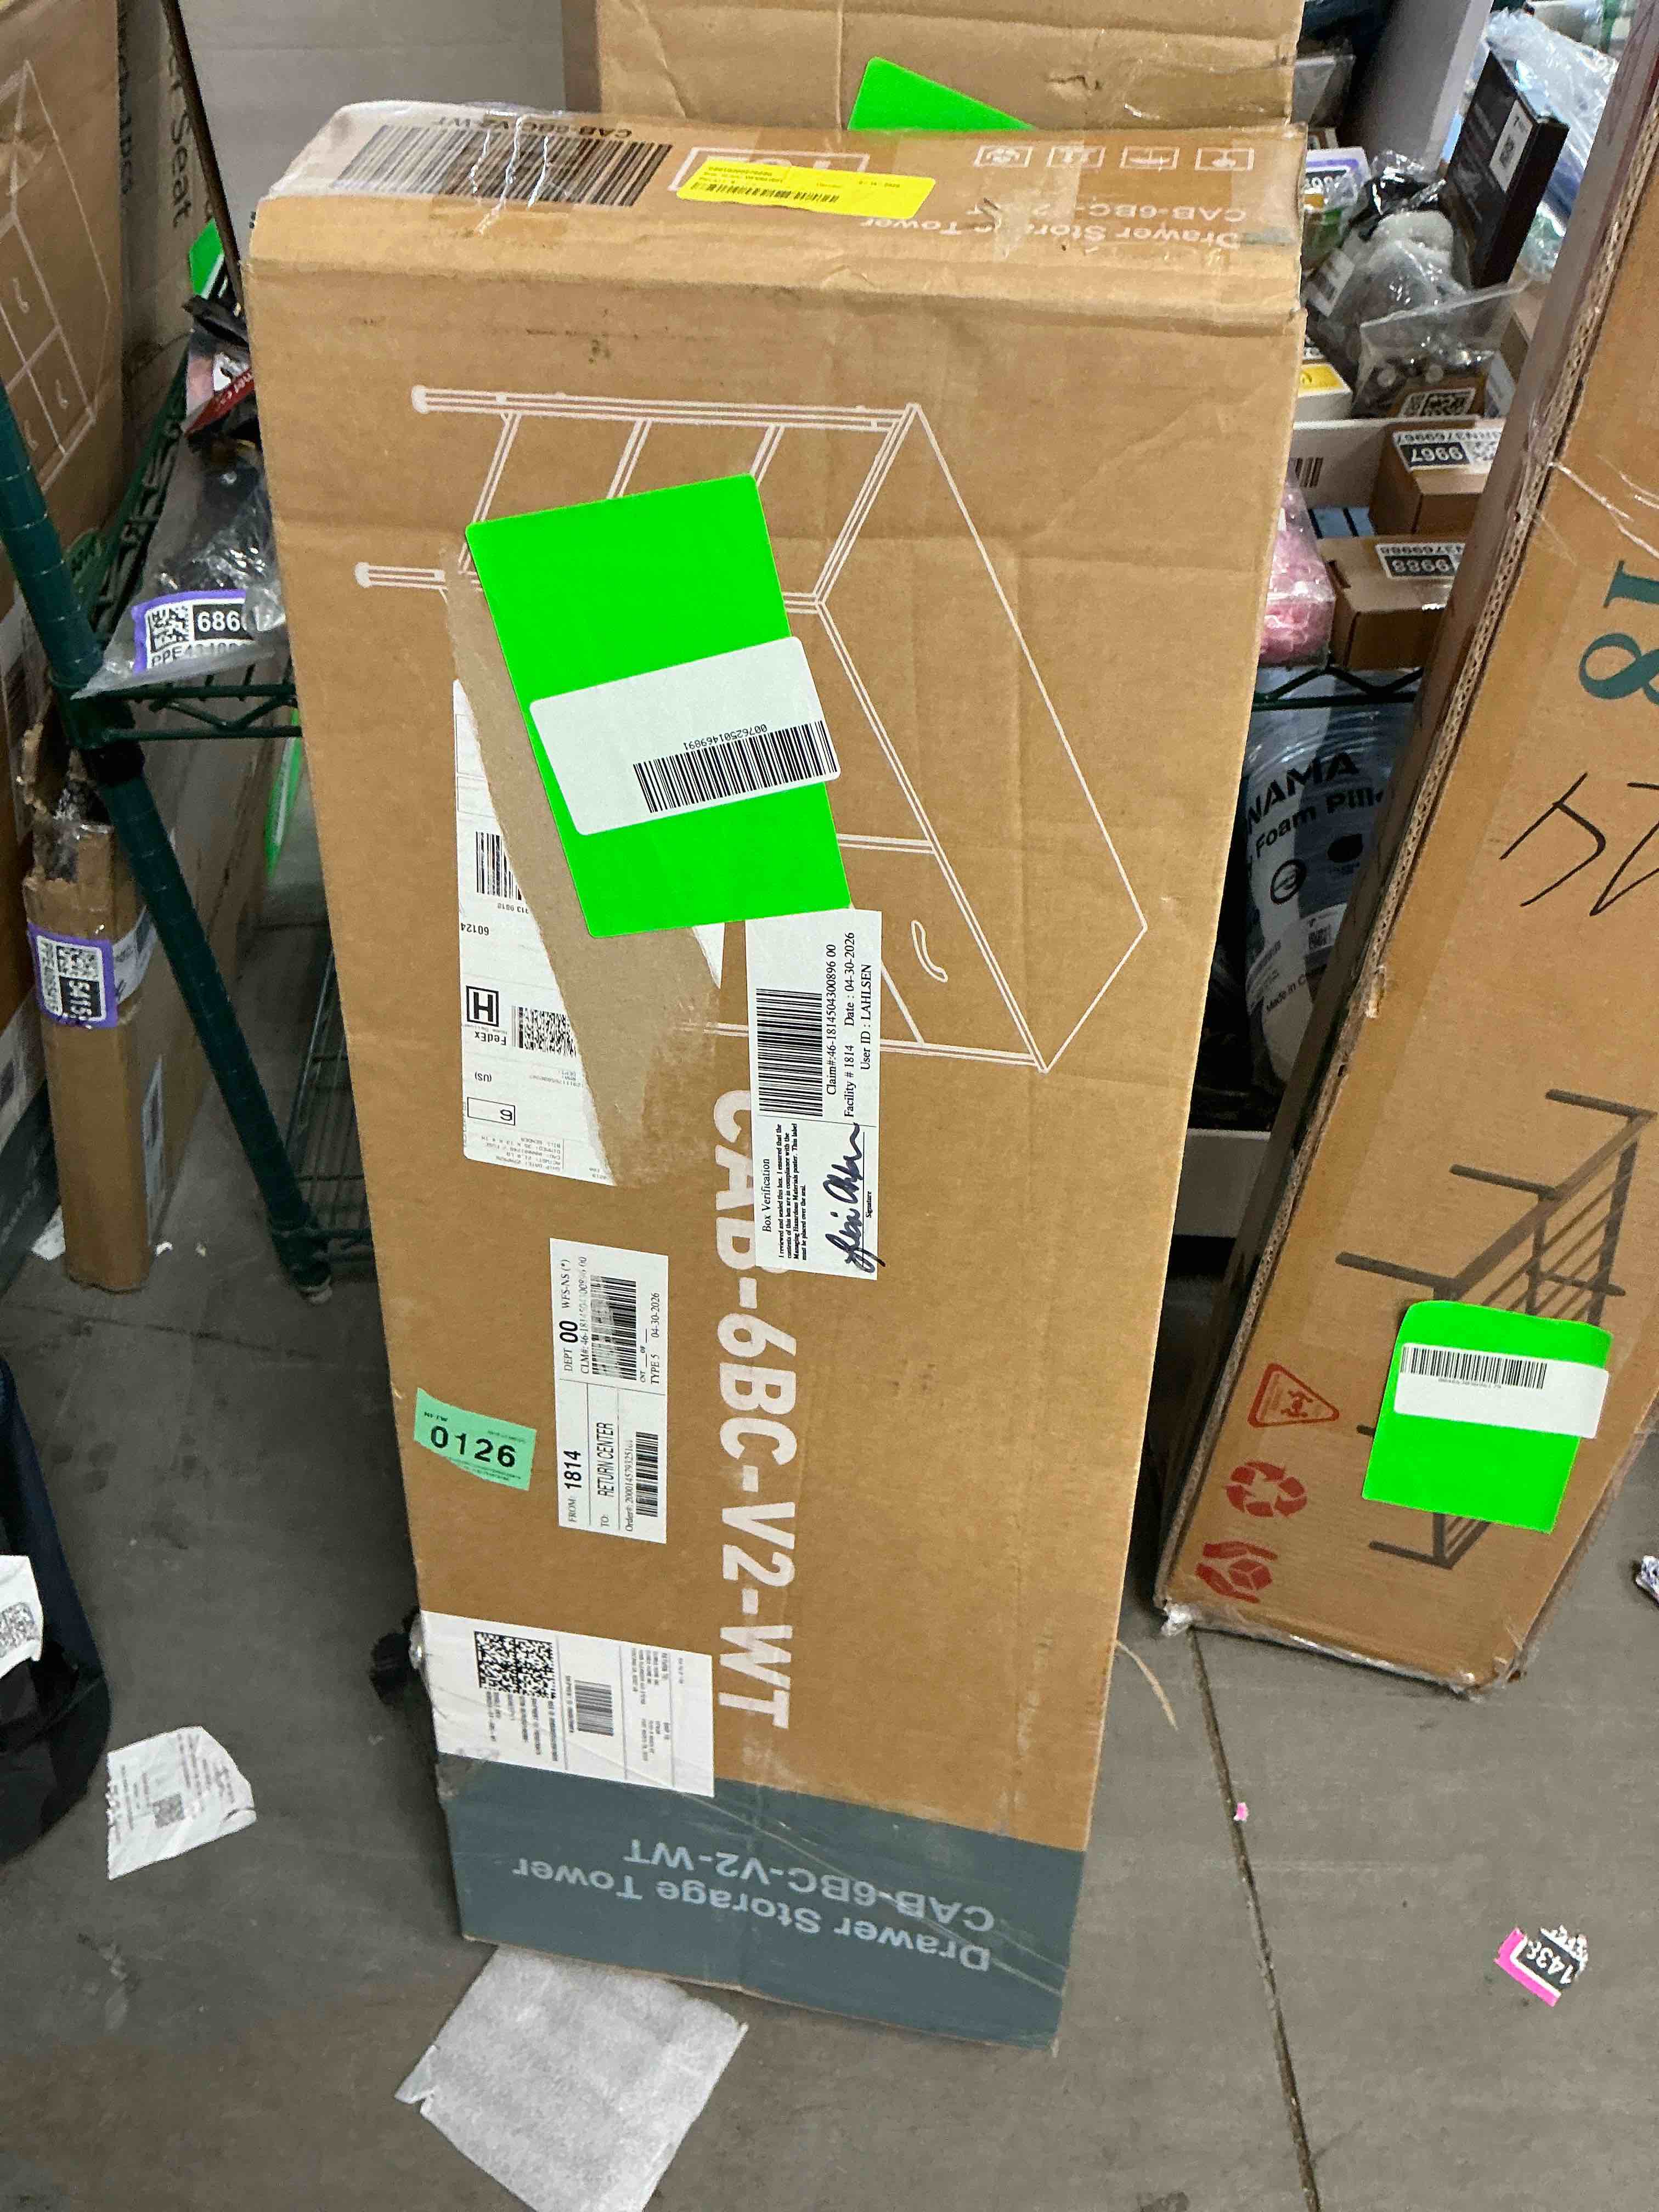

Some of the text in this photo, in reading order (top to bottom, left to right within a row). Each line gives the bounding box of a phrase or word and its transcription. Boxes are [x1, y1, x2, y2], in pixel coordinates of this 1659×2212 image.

[1117, 227, 1240, 249] Drawer
[197, 610, 250, 633] 686
[683, 724, 768, 751] 00762501469891
[1326, 787, 1385, 815] Pill
[460, 922, 489, 936] 60124
[826, 944, 836, 957] 00
[845, 933, 854, 991] 04-30-2026
[861, 964, 871, 1020] LAHLSEN
[473, 991, 494, 1022] H
[845, 1002, 854, 1025] Date
[475, 1031, 506, 1046] FedEx
[861, 1031, 871, 1044] ID
[845, 1045, 854, 1066] 1814
[861, 1048, 871, 1070] User
[475, 1072, 492, 1082] (US)
[844, 1082, 856, 1117] Facility
[500, 1109, 513, 1121] 6
[761, 1159, 771, 1232] Box Verification
[561, 1274, 570, 1308] WFS-NS
[651, 1293, 659, 1338] 04-30-2026
[559, 1321, 578, 1342] 00
[564, 1348, 573, 1371] DEPT
[651, 1361, 660, 1384] TYPE
[431, 1425, 516, 1468] 0126
[596, 1423, 613, 1459] CENTER
[563, 1451, 582, 1489] 1814
[597, 1462, 614, 1497] RETURN
[624, 1839, 995, 1933] CAB-6BC-V2-WT
[512, 1857, 990, 1971] Drawer Storage Tower
